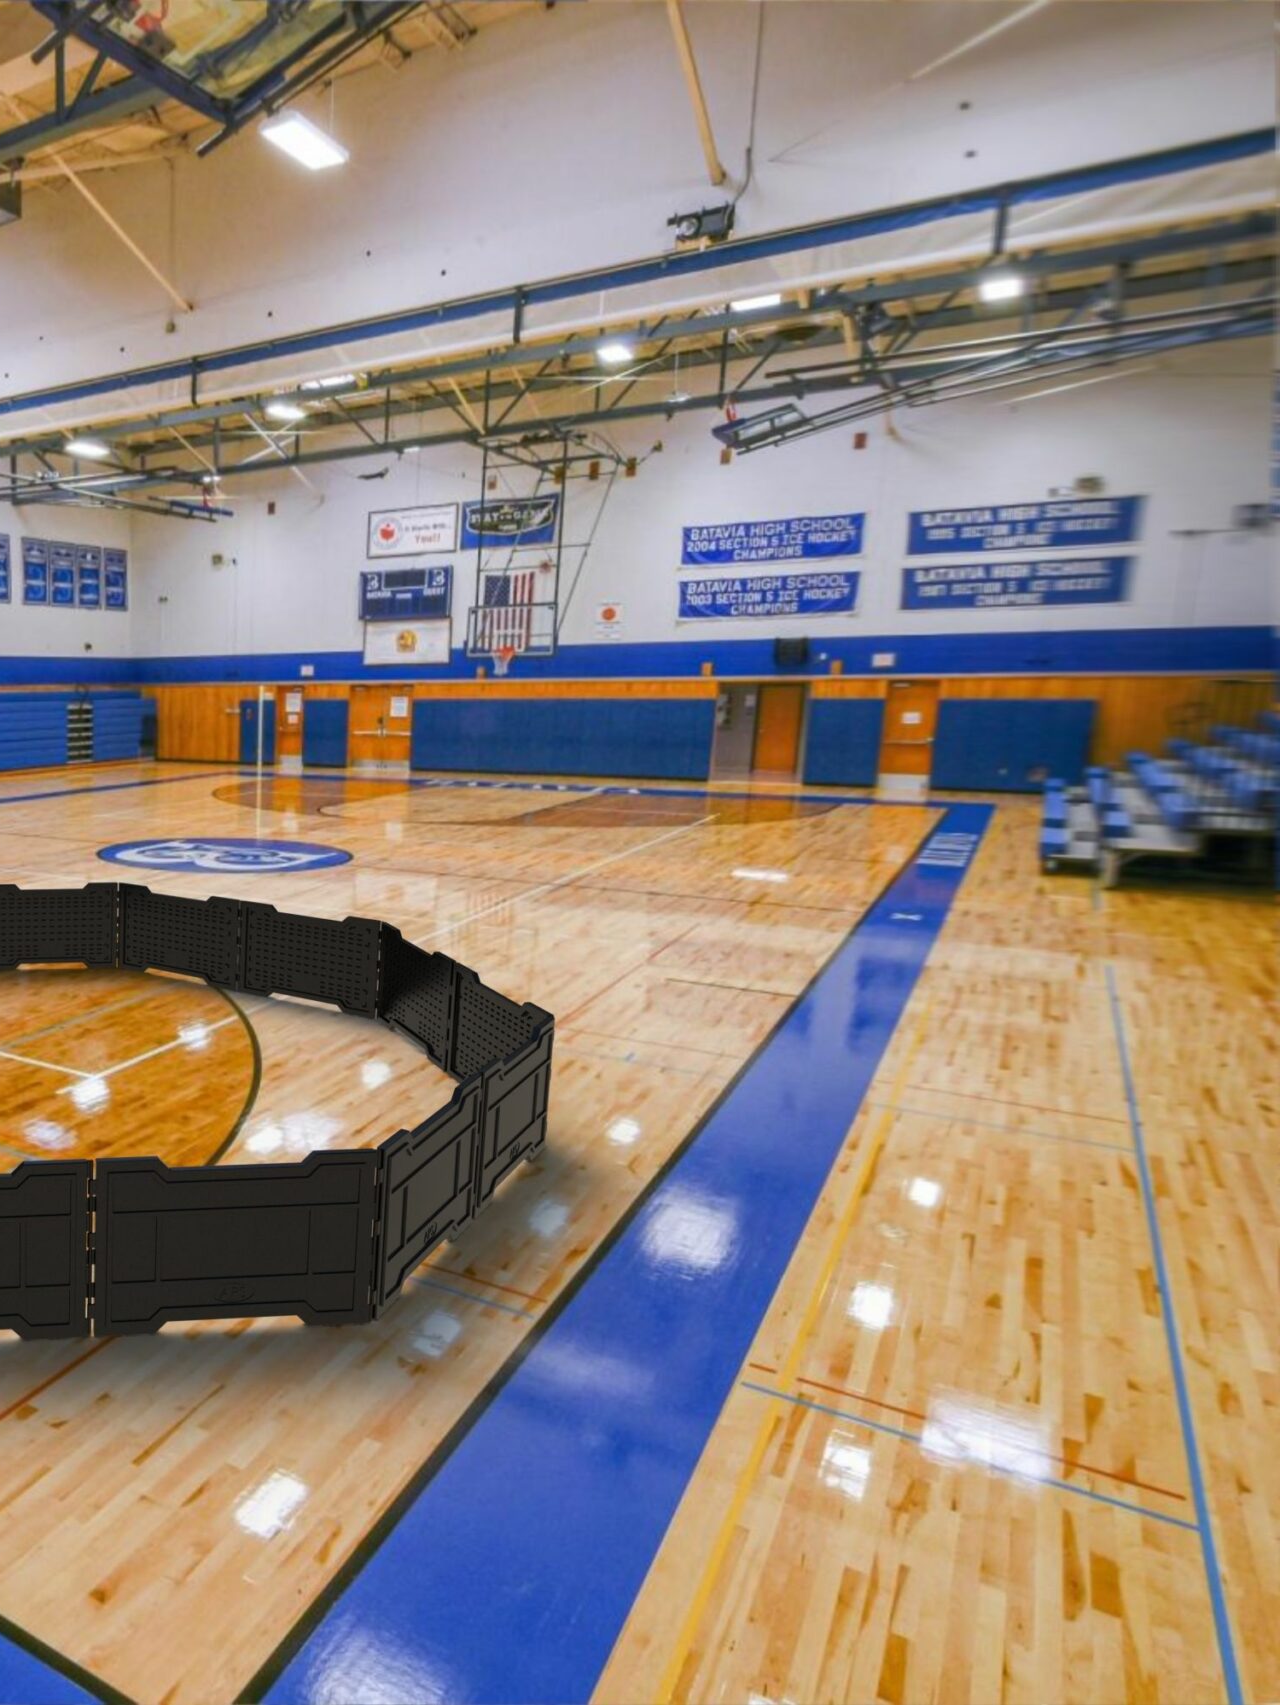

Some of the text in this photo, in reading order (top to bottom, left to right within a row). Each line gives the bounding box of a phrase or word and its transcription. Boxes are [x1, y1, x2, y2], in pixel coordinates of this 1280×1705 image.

[691, 518, 855, 541] BATAVIA HIGH SCHOOL
[687, 529, 856, 552] 2004 SECTION 5 ICE HOCKEY
[732, 546, 803, 560] CHAMPIONS
[687, 575, 850, 595] BATAVIA HIGH SCHOOL
[716, 592, 762, 605] SECTION
[765, 592, 774, 602] 5
[778, 589, 800, 602] ICE
[802, 587, 850, 600] HOCKEY
[730, 602, 799, 616] CHAMPIONS
